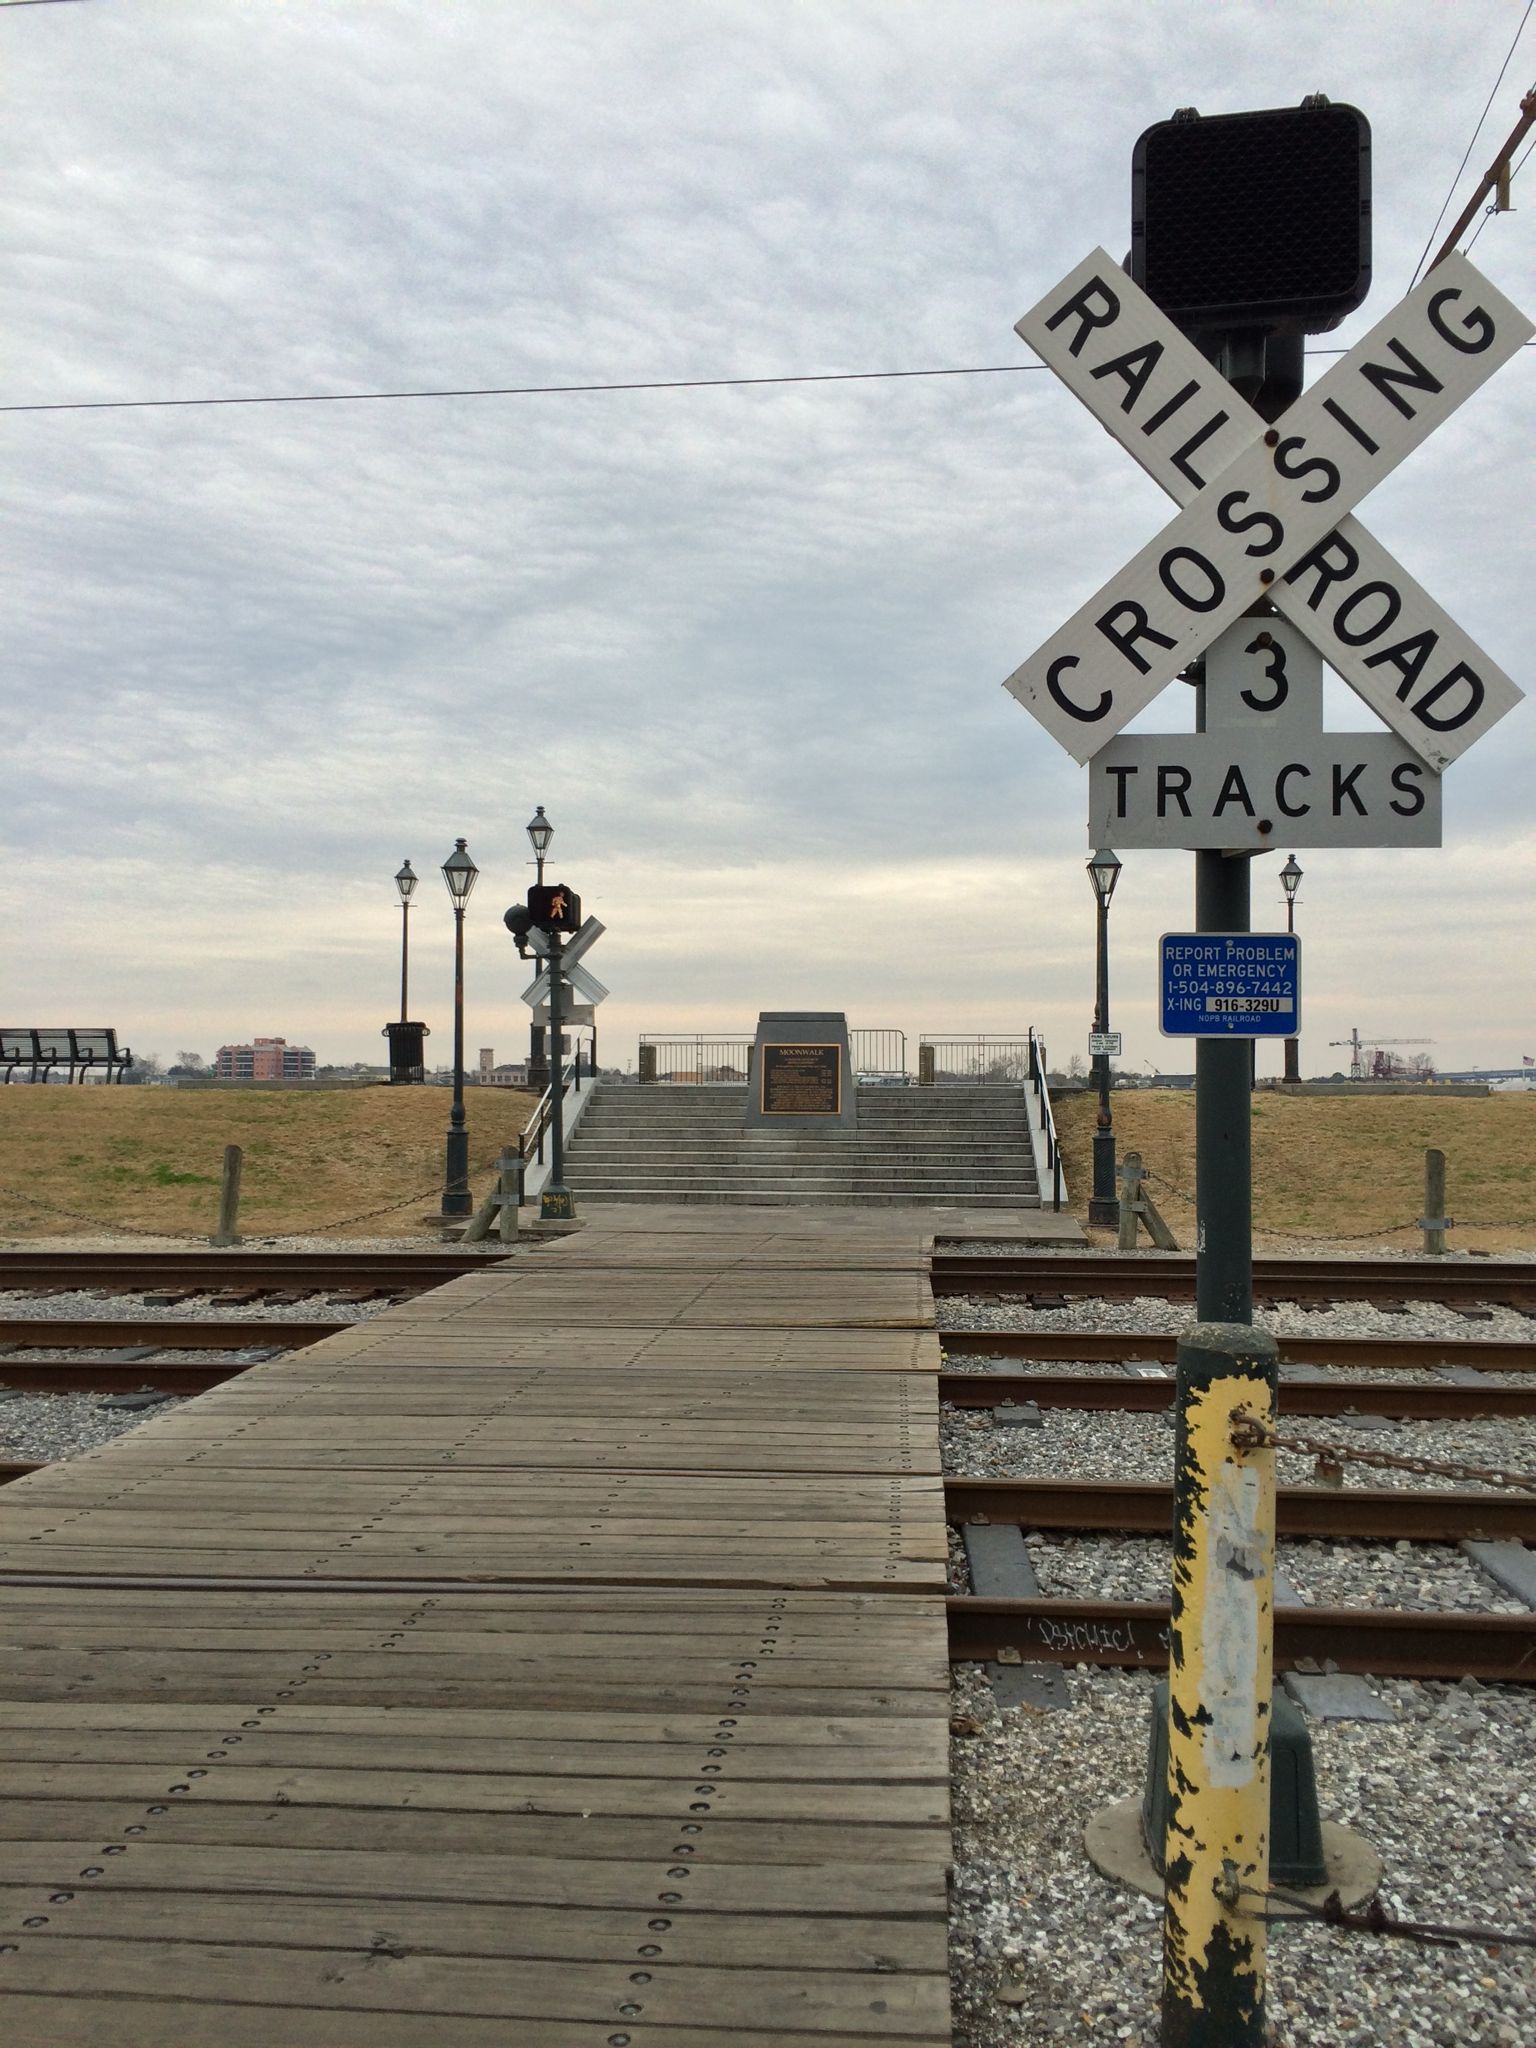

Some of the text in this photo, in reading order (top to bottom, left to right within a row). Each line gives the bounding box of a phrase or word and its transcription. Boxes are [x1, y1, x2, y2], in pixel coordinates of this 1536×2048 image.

[1044, 274, 1485, 733] RAIL ROAD
[1046, 287, 1496, 723] CROSSING
[1240, 639, 1289, 712] 3
[1105, 762, 1426, 818] TRACKS
[1166, 947, 1295, 960] REPORT PROBLEM
[1173, 963, 1287, 977] OR EMERGENCY
[1168, 981, 1292, 994] 1-504-896-7442
[1167, 997, 1280, 1012] X-ING 916-329U
[1222, 1015, 1262, 1023] RAILROAD
